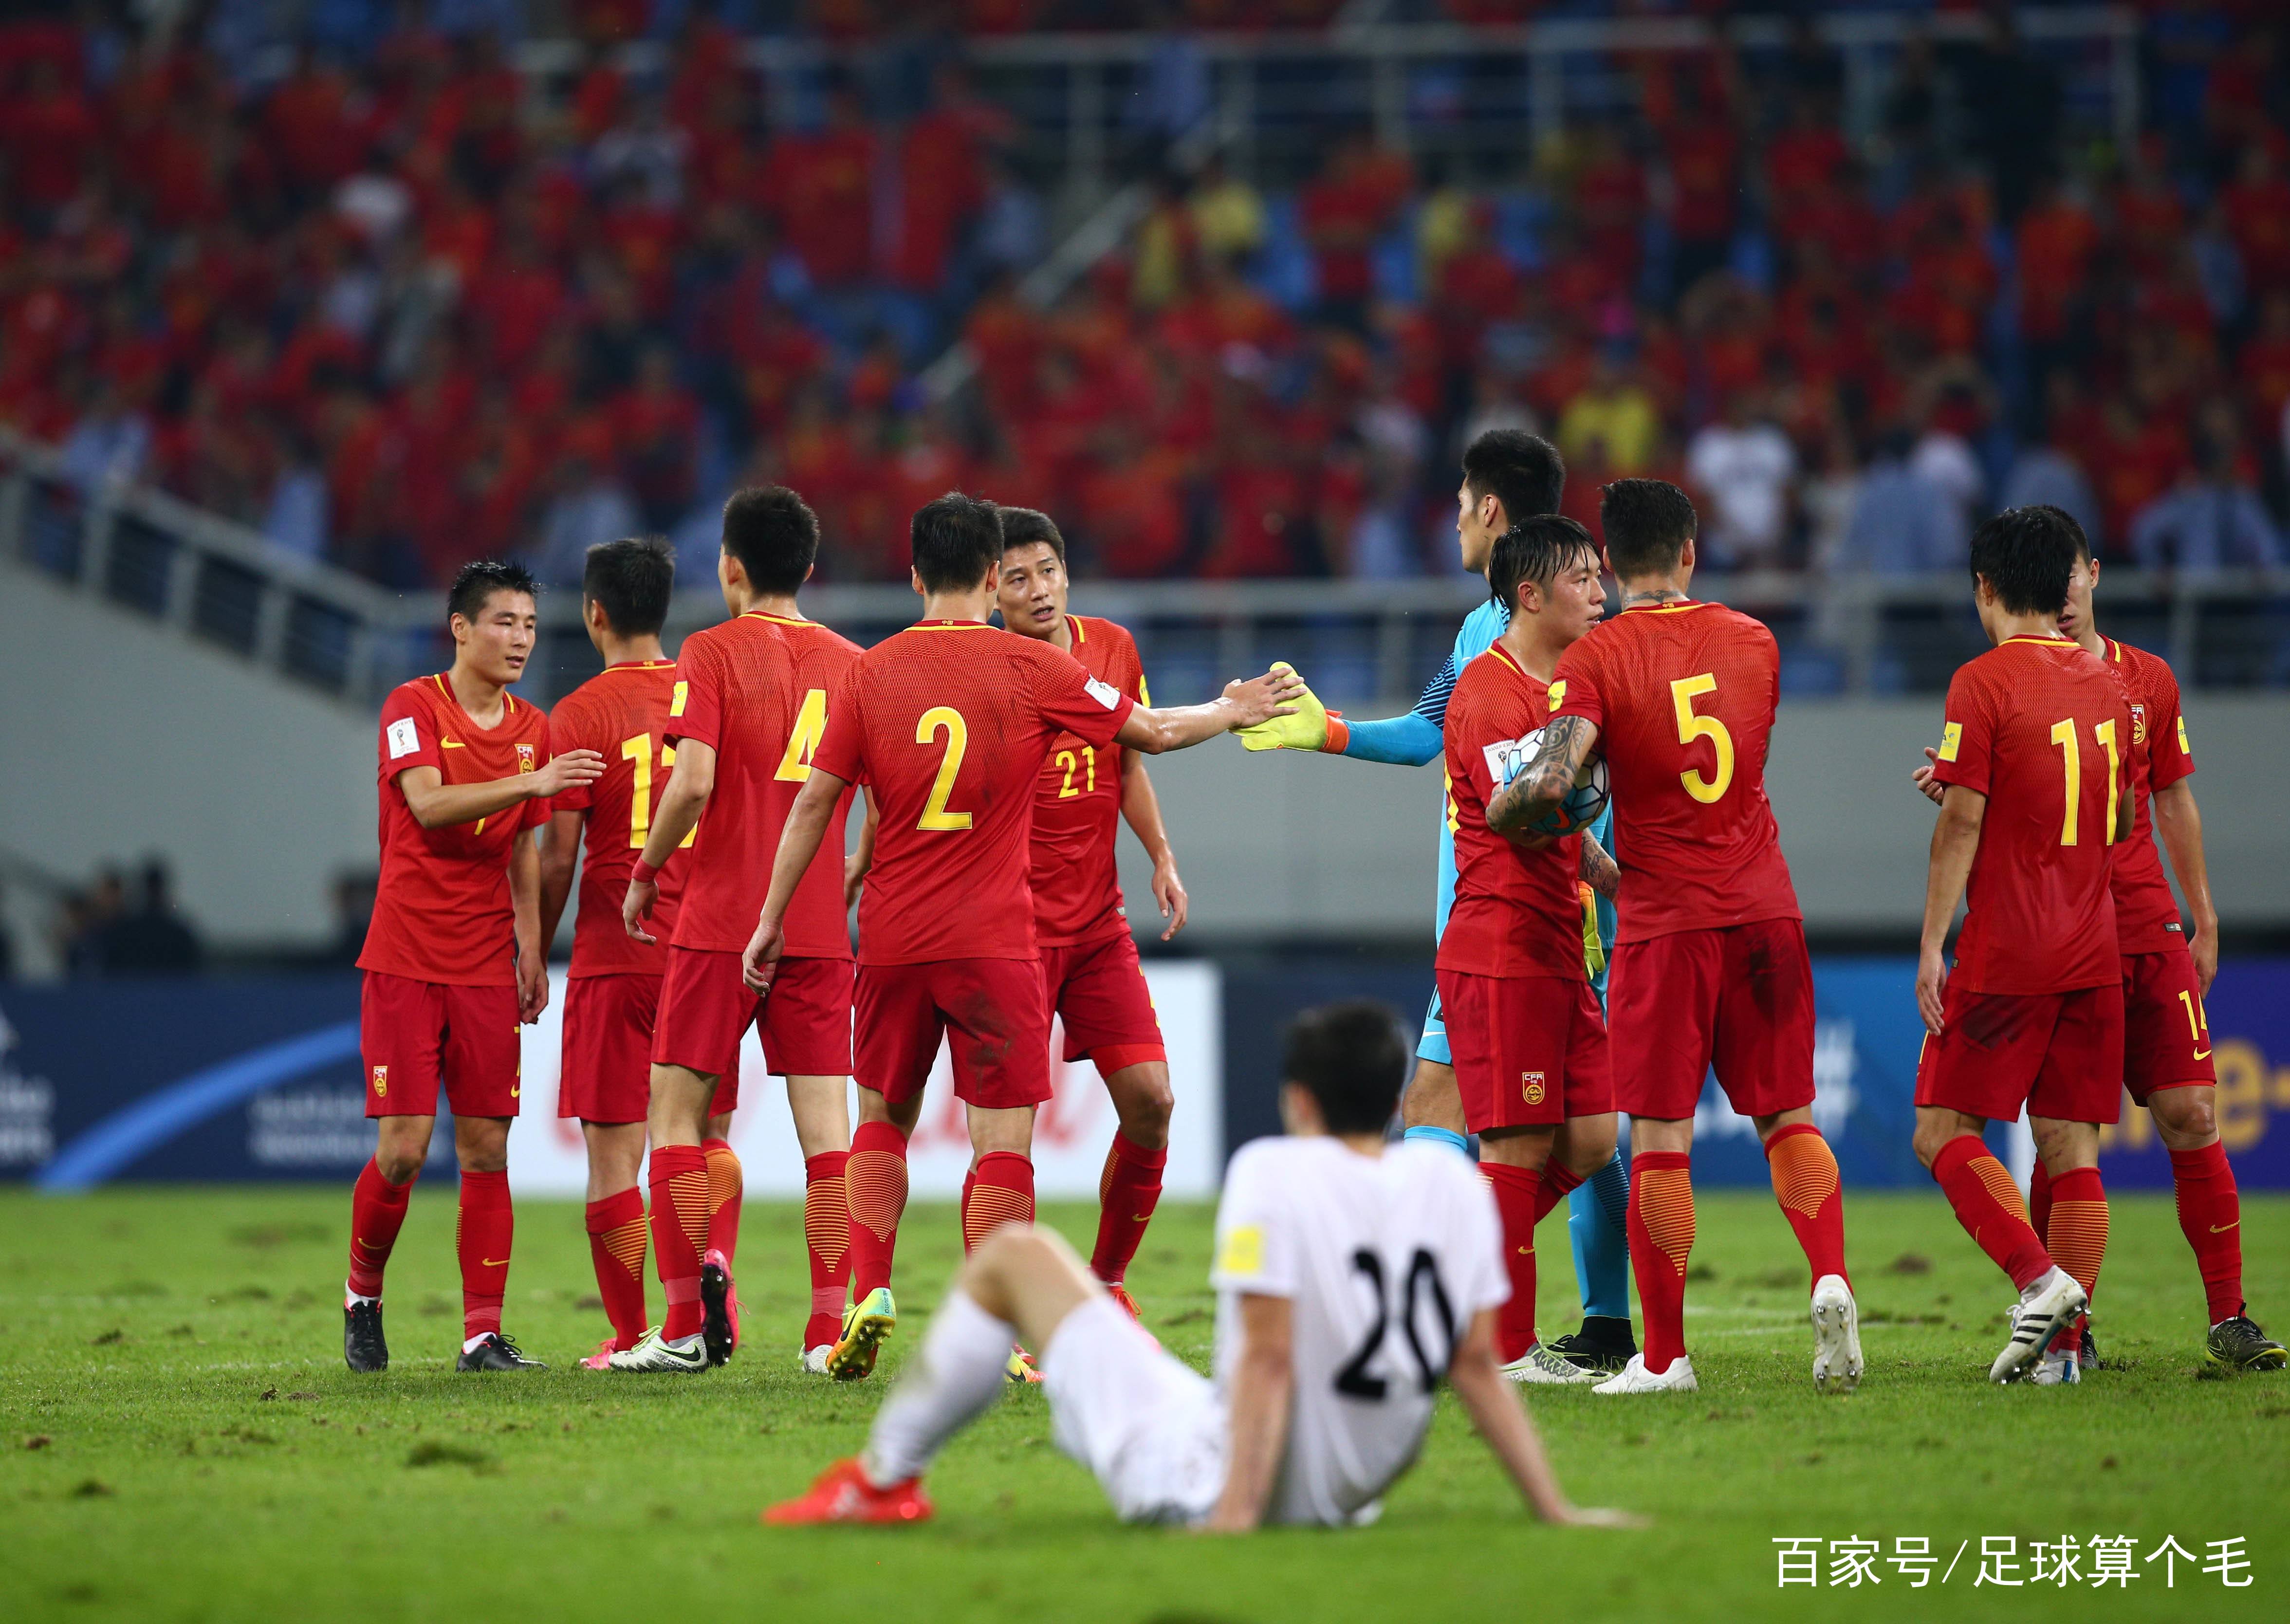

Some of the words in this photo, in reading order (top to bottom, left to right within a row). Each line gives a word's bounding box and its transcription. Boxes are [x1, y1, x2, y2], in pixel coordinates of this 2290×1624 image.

[773, 688, 830, 782] 4
[916, 706, 972, 830] 2
[1055, 745, 1094, 798] 21
[1485, 741, 1514, 753] QUALIFIERS
[1670, 672, 1734, 803] 5
[2051, 718, 2119, 846] 11
[1333, 1247, 1455, 1401] 20
